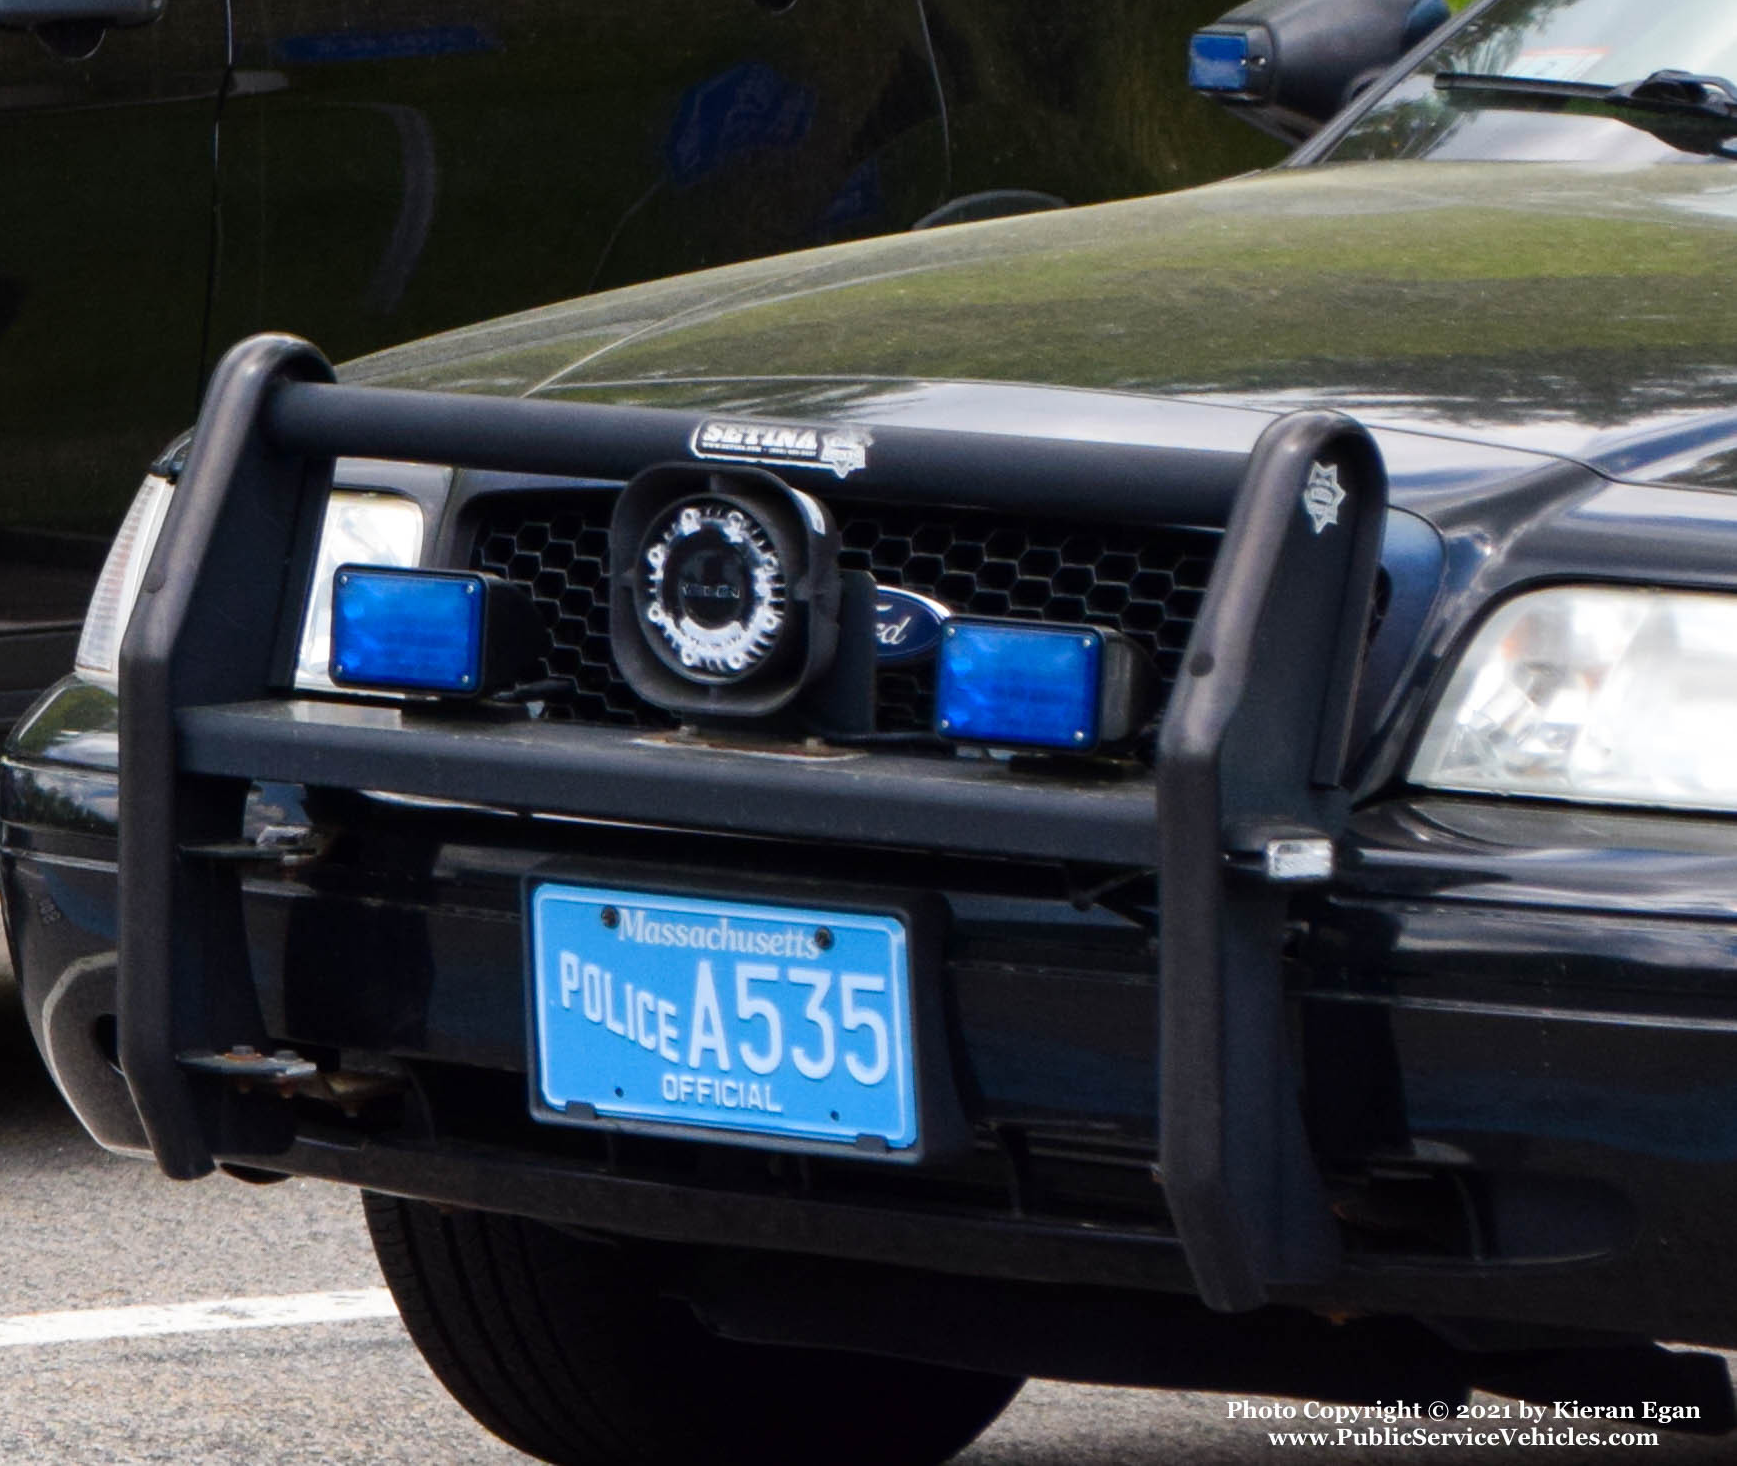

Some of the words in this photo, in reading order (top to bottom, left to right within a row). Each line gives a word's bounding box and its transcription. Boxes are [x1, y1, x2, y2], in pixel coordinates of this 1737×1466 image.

[702, 424, 818, 449] SETINA
[618, 909, 821, 959] Massachusetts
[559, 949, 681, 1064] POLICE
[688, 960, 890, 1085] A535
[661, 1072, 784, 1113] OFFICIAL
